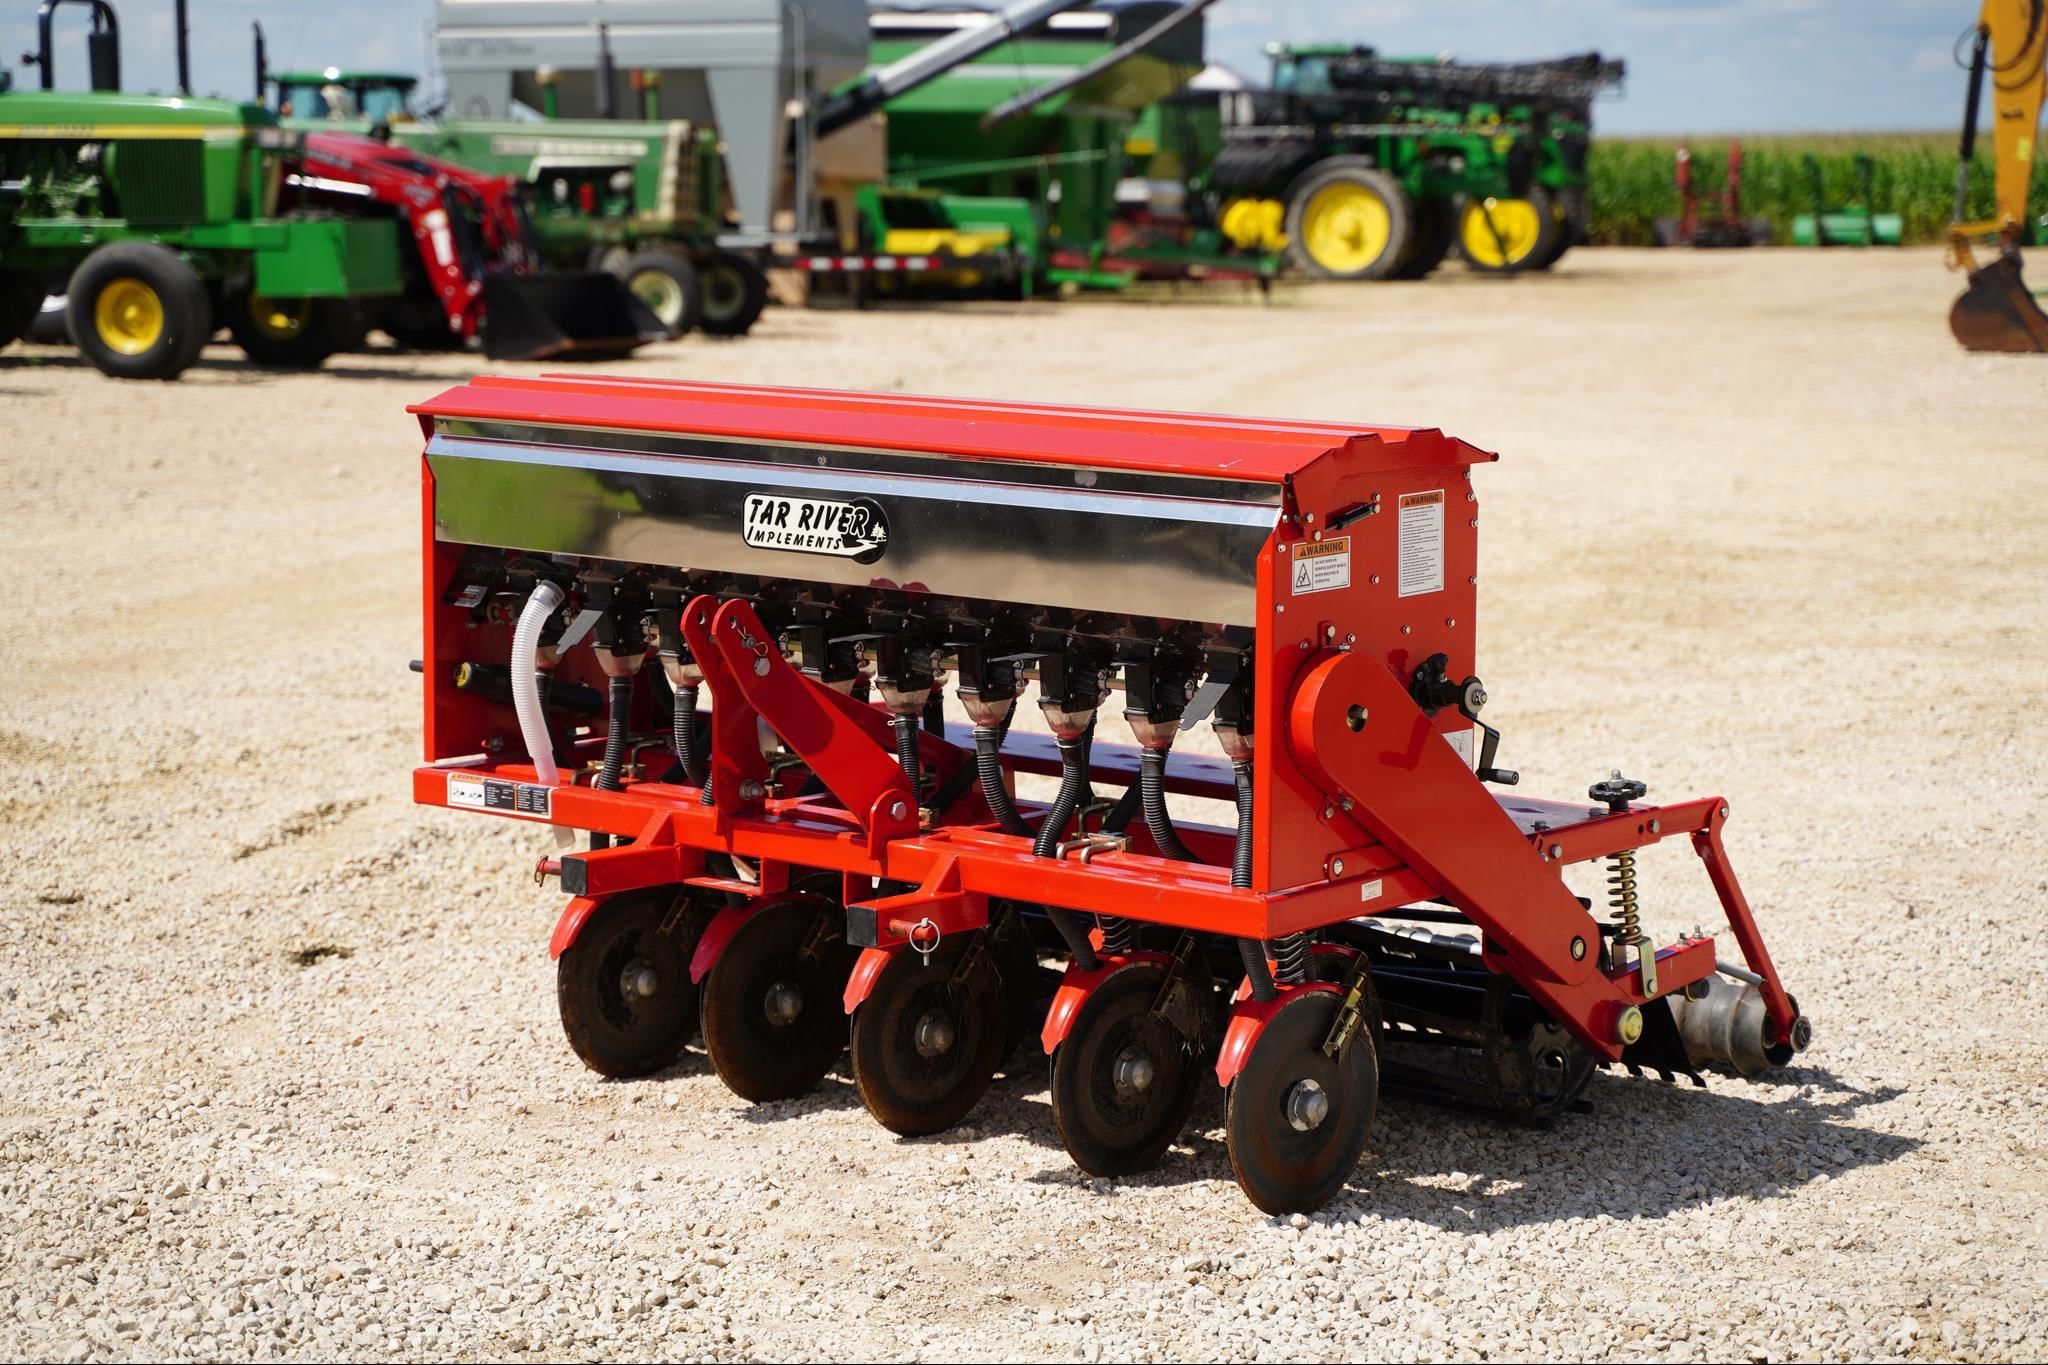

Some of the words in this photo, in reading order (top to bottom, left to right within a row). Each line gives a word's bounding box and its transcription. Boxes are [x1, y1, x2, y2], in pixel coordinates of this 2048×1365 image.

[1410, 494, 1439, 504] WARNING
[749, 498, 791, 528] TAR
[798, 503, 868, 537] RIVER
[747, 526, 843, 550] IMPLEMENTS
[1307, 542, 1343, 555] WARNING
